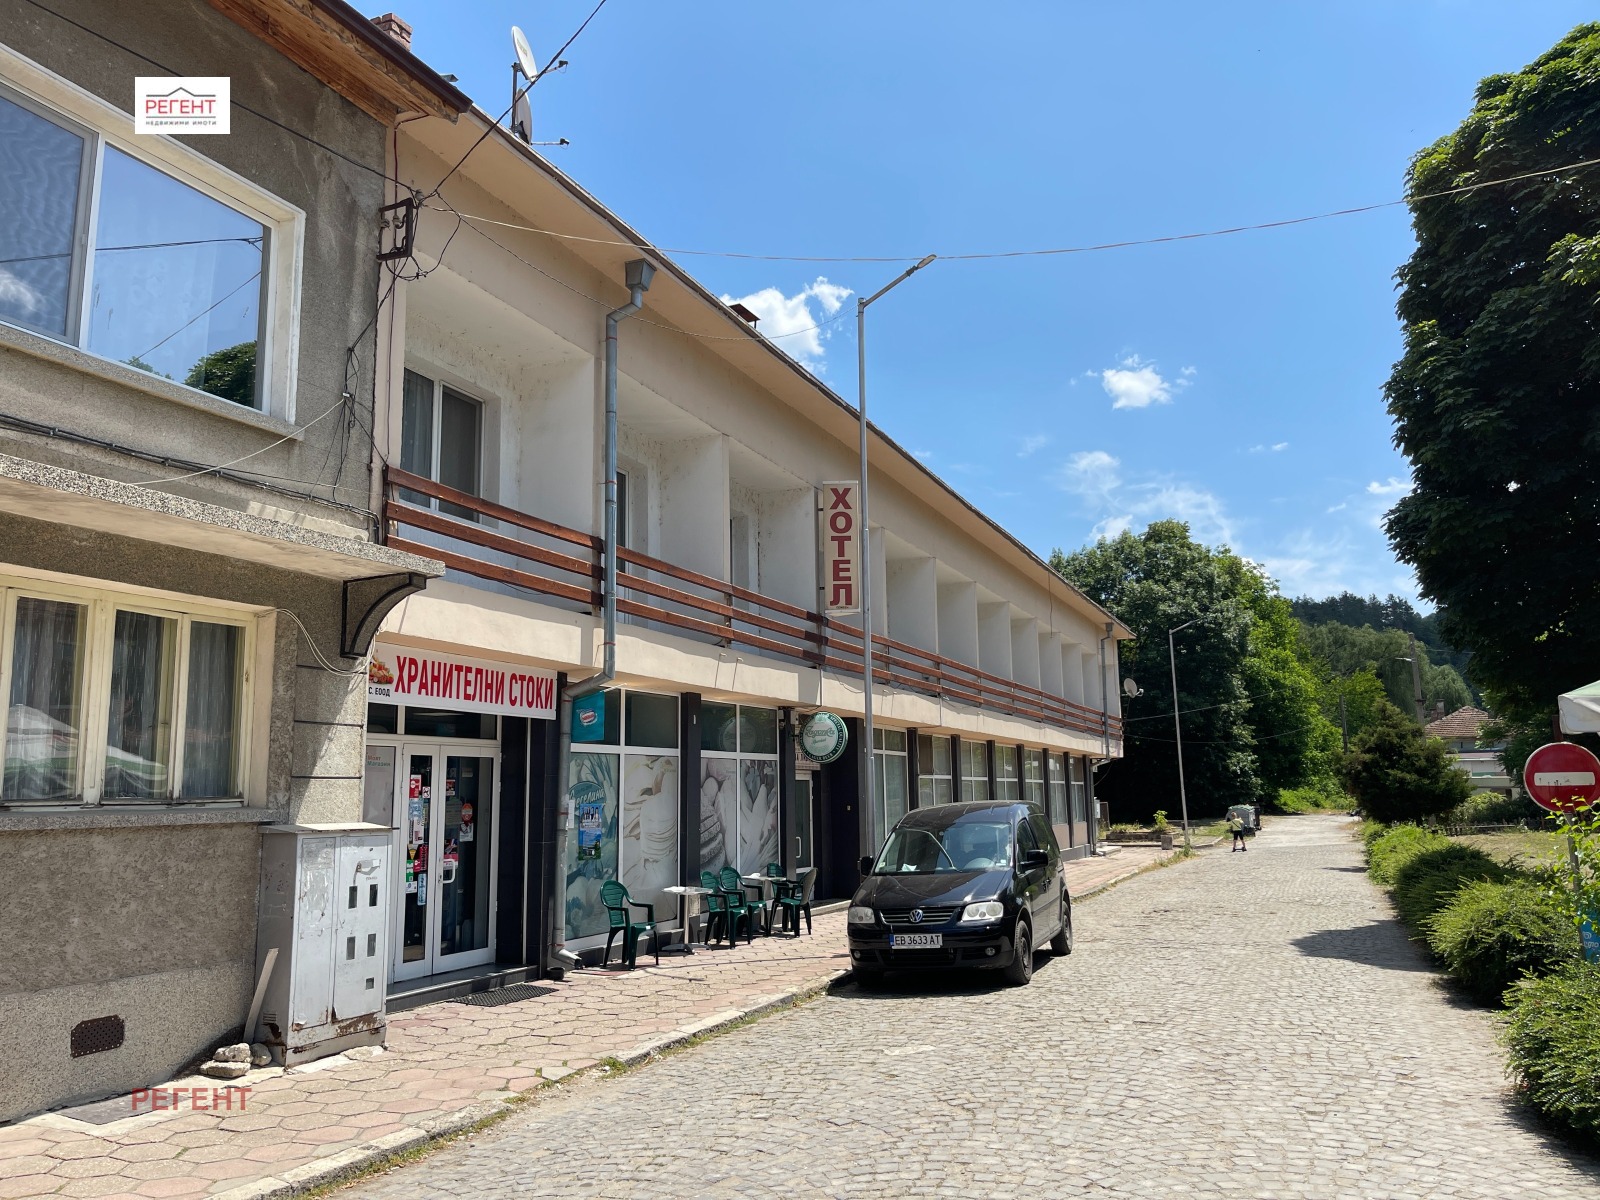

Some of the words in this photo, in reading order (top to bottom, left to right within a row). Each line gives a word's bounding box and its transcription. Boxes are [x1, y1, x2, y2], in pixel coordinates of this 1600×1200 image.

[829, 487, 853, 606] ХОТЕЛ
[375, 687, 391, 698] ЕООД
[395, 656, 504, 705] ХРАНИТЕЛНИ
[508, 672, 554, 710] СТОКИ
[907, 936, 928, 945] 3633
[930, 935, 940, 945] AT
